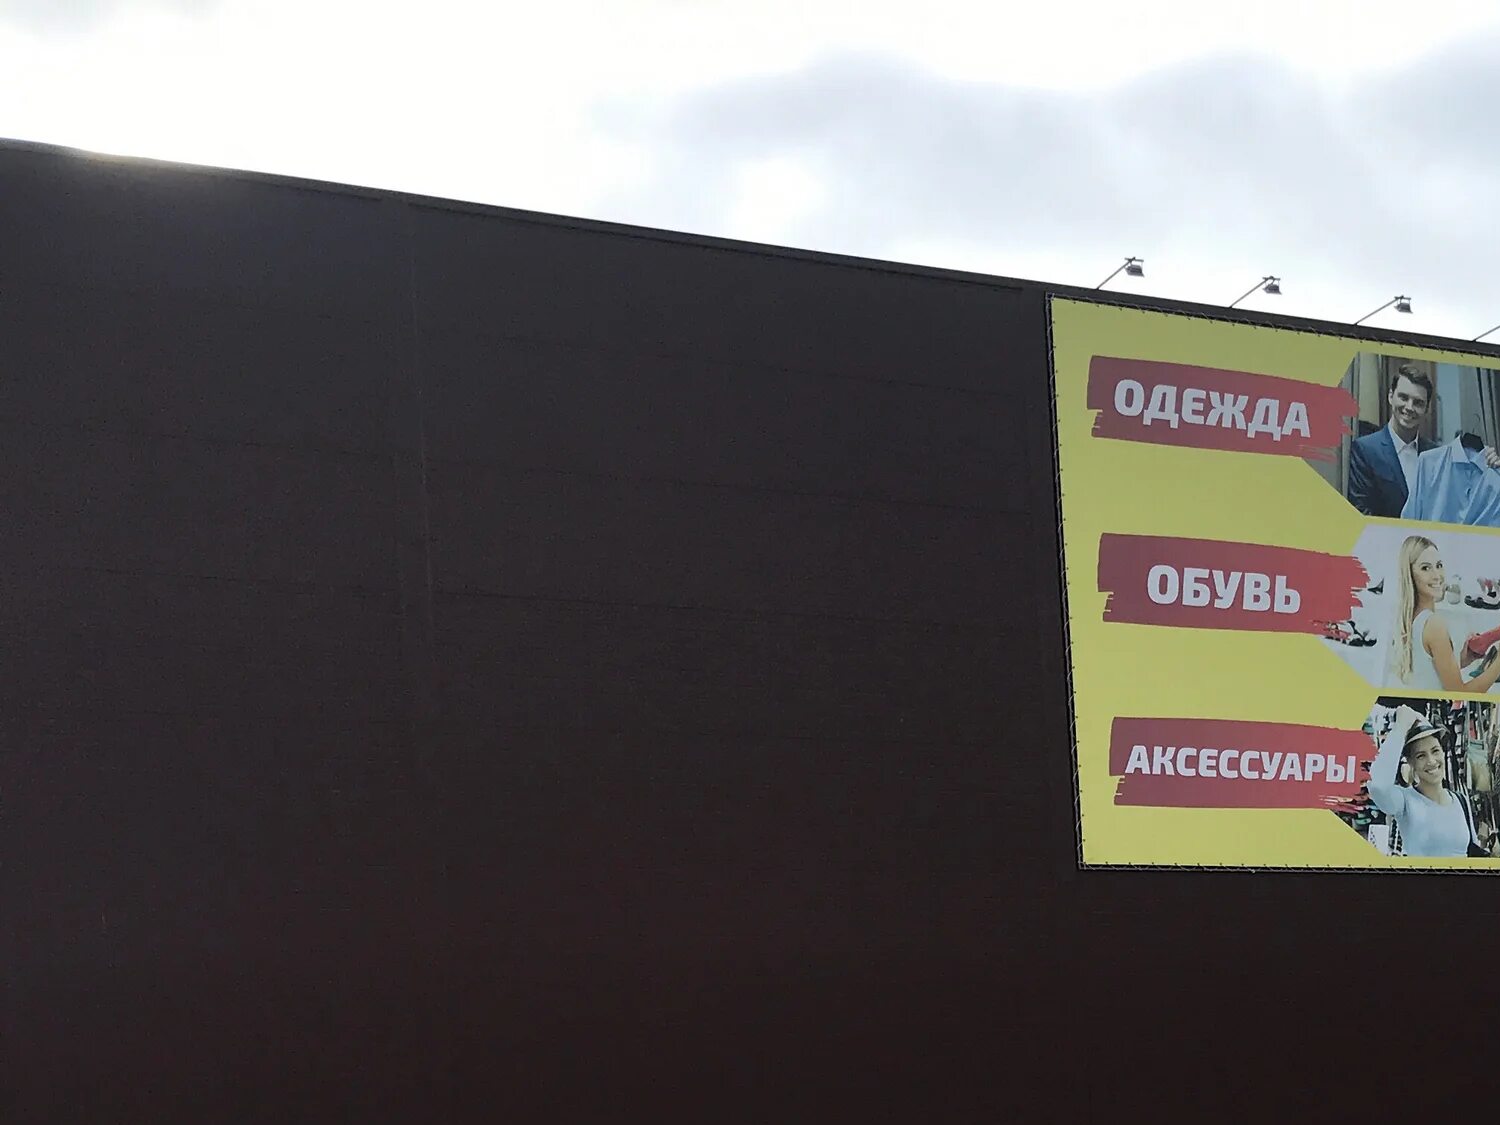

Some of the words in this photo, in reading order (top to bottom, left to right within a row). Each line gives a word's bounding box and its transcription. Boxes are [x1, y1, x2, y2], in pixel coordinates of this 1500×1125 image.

[1113, 378, 1311, 441] ОДЕЖДА
[1146, 564, 1300, 614] ОБУВЬ
[1124, 744, 1356, 784] АКСЕССУАРЫ
